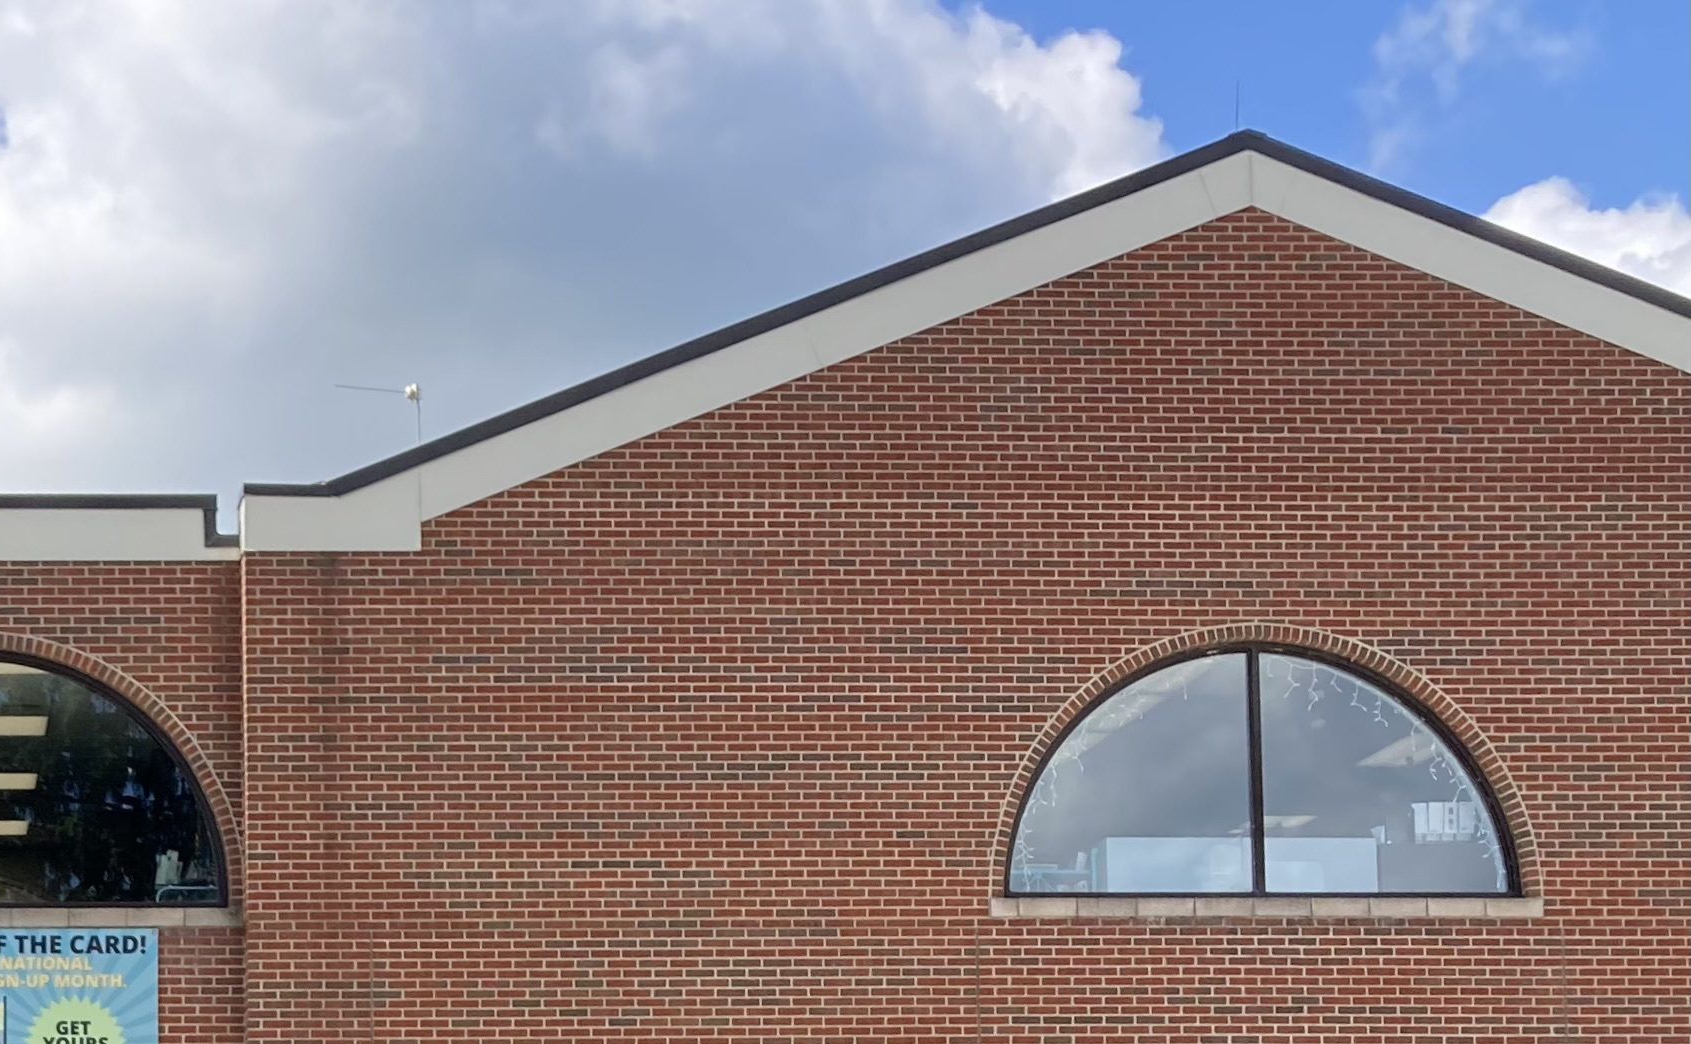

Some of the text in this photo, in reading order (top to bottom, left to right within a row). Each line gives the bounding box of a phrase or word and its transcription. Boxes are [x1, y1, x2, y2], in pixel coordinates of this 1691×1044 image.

[14, 934, 62, 955] THE
[69, 934, 147, 955] CARD!
[0, 956, 93, 971] NATIONAL
[54, 974, 128, 988] MONTH.
[56, 1020, 91, 1035] GET
